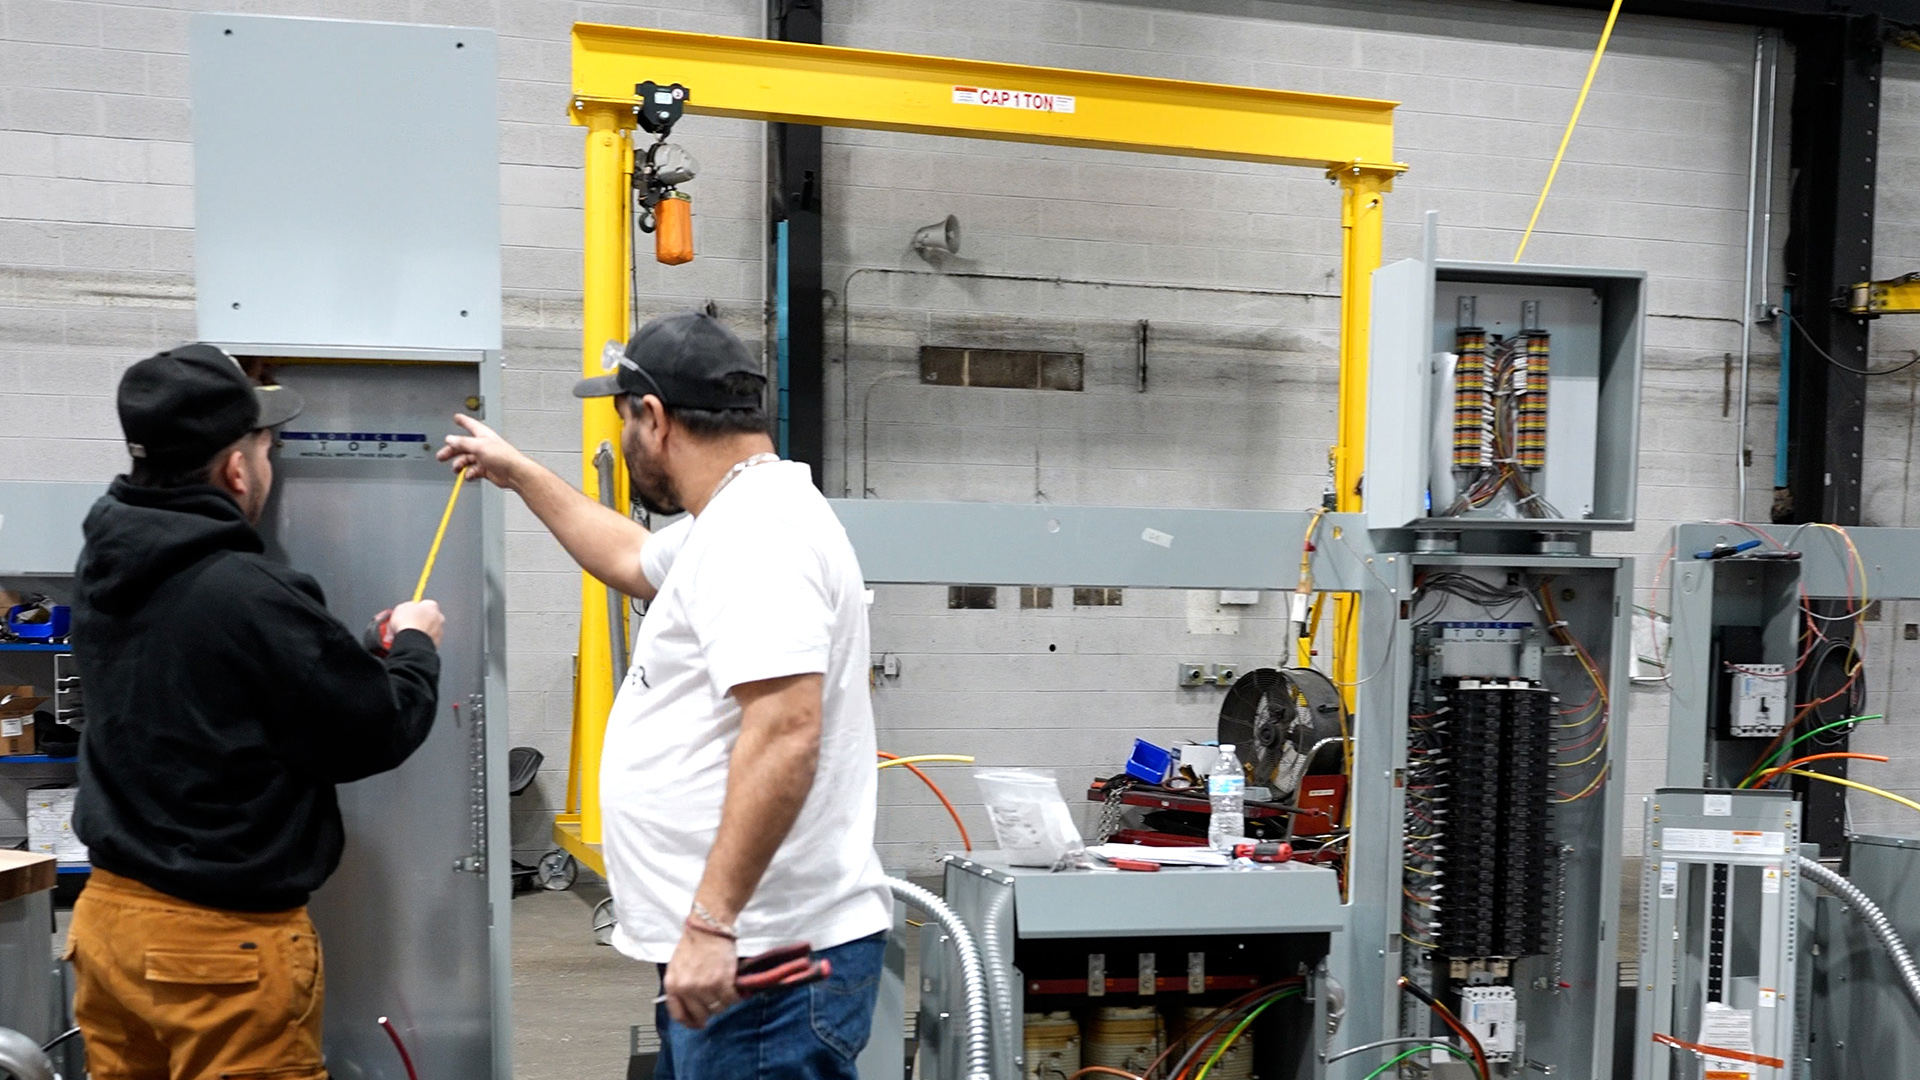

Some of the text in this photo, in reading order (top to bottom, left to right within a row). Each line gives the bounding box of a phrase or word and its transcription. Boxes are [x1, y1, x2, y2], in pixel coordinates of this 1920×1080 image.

[980, 89, 1010, 106] CAP
[1014, 93, 1020, 107] 1
[1024, 94, 1053, 110] TON
[311, 433, 399, 441] NOTICE
